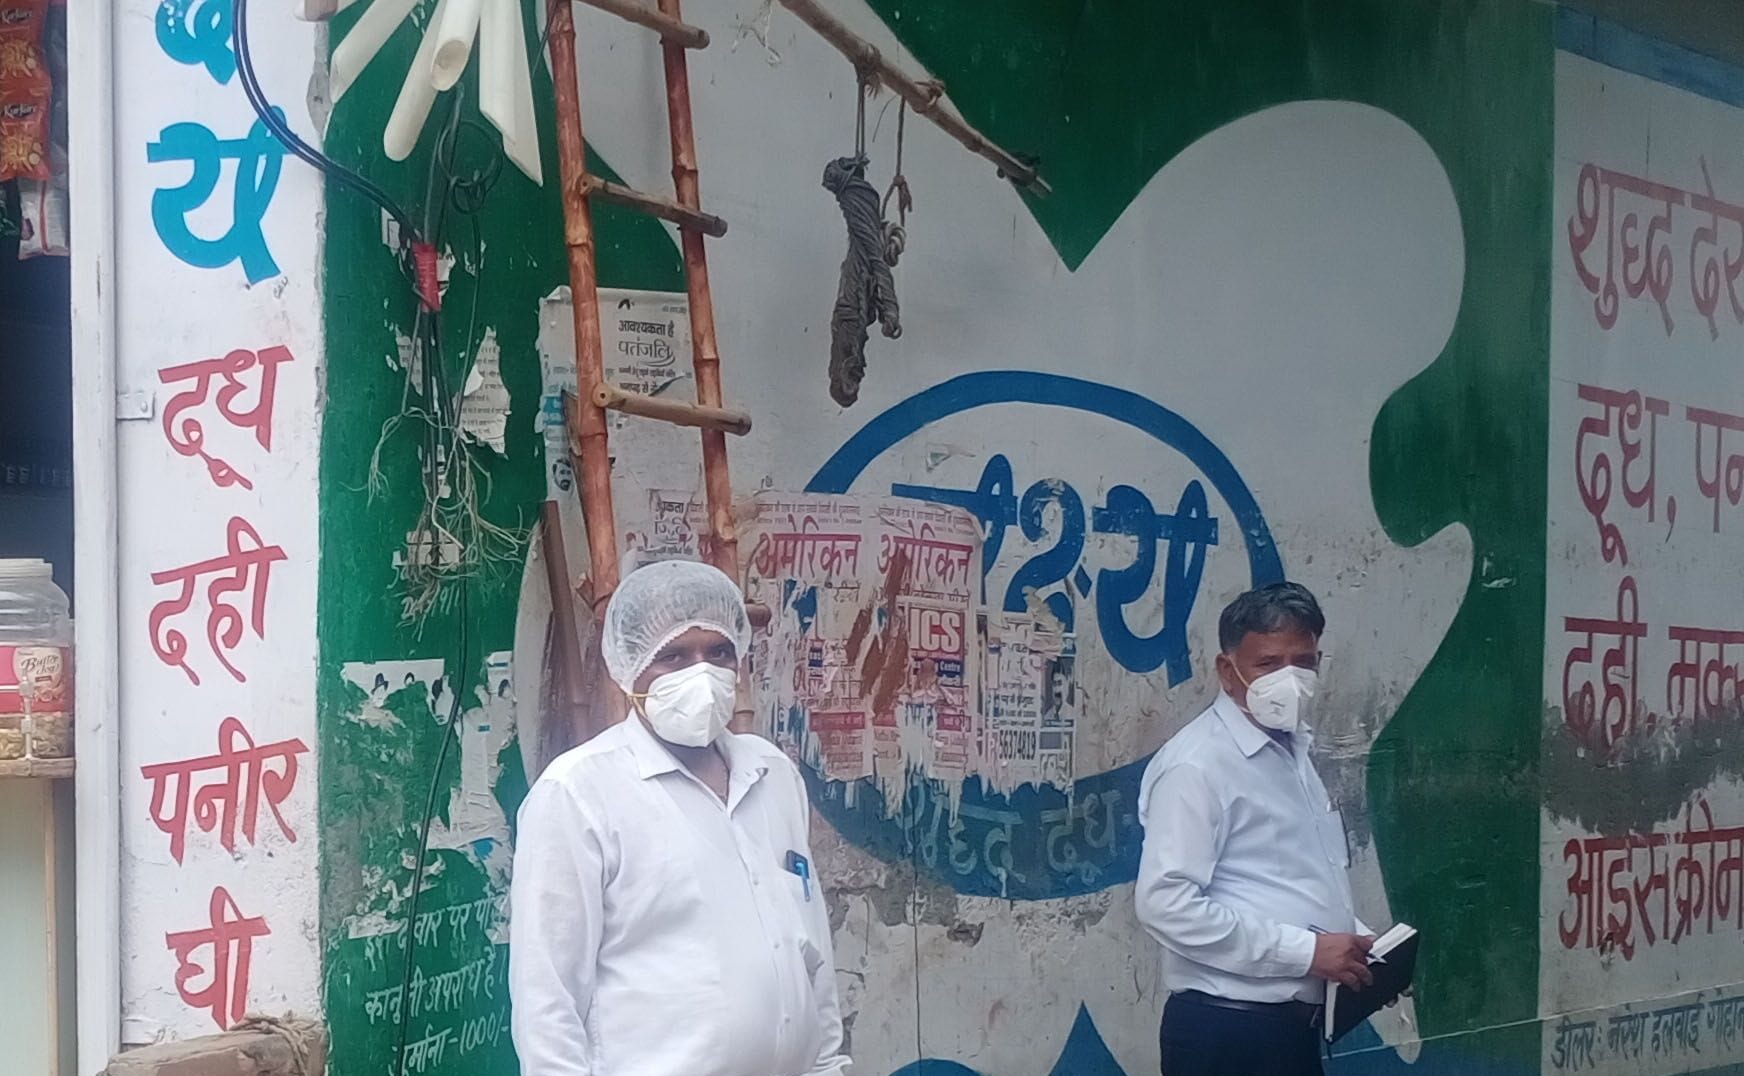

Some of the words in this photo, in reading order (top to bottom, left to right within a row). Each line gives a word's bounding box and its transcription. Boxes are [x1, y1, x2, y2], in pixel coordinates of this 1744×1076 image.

[618, 336, 672, 359] पतंजलि
[158, 345, 294, 491] दूध
[756, 513, 862, 579] अमेरिकन
[877, 519, 974, 585] अमेरिकन
[150, 516, 288, 686] दही
[909, 608, 961, 653] ICS
[141, 717, 309, 867] पनीर
[165, 886, 271, 1031] घी
